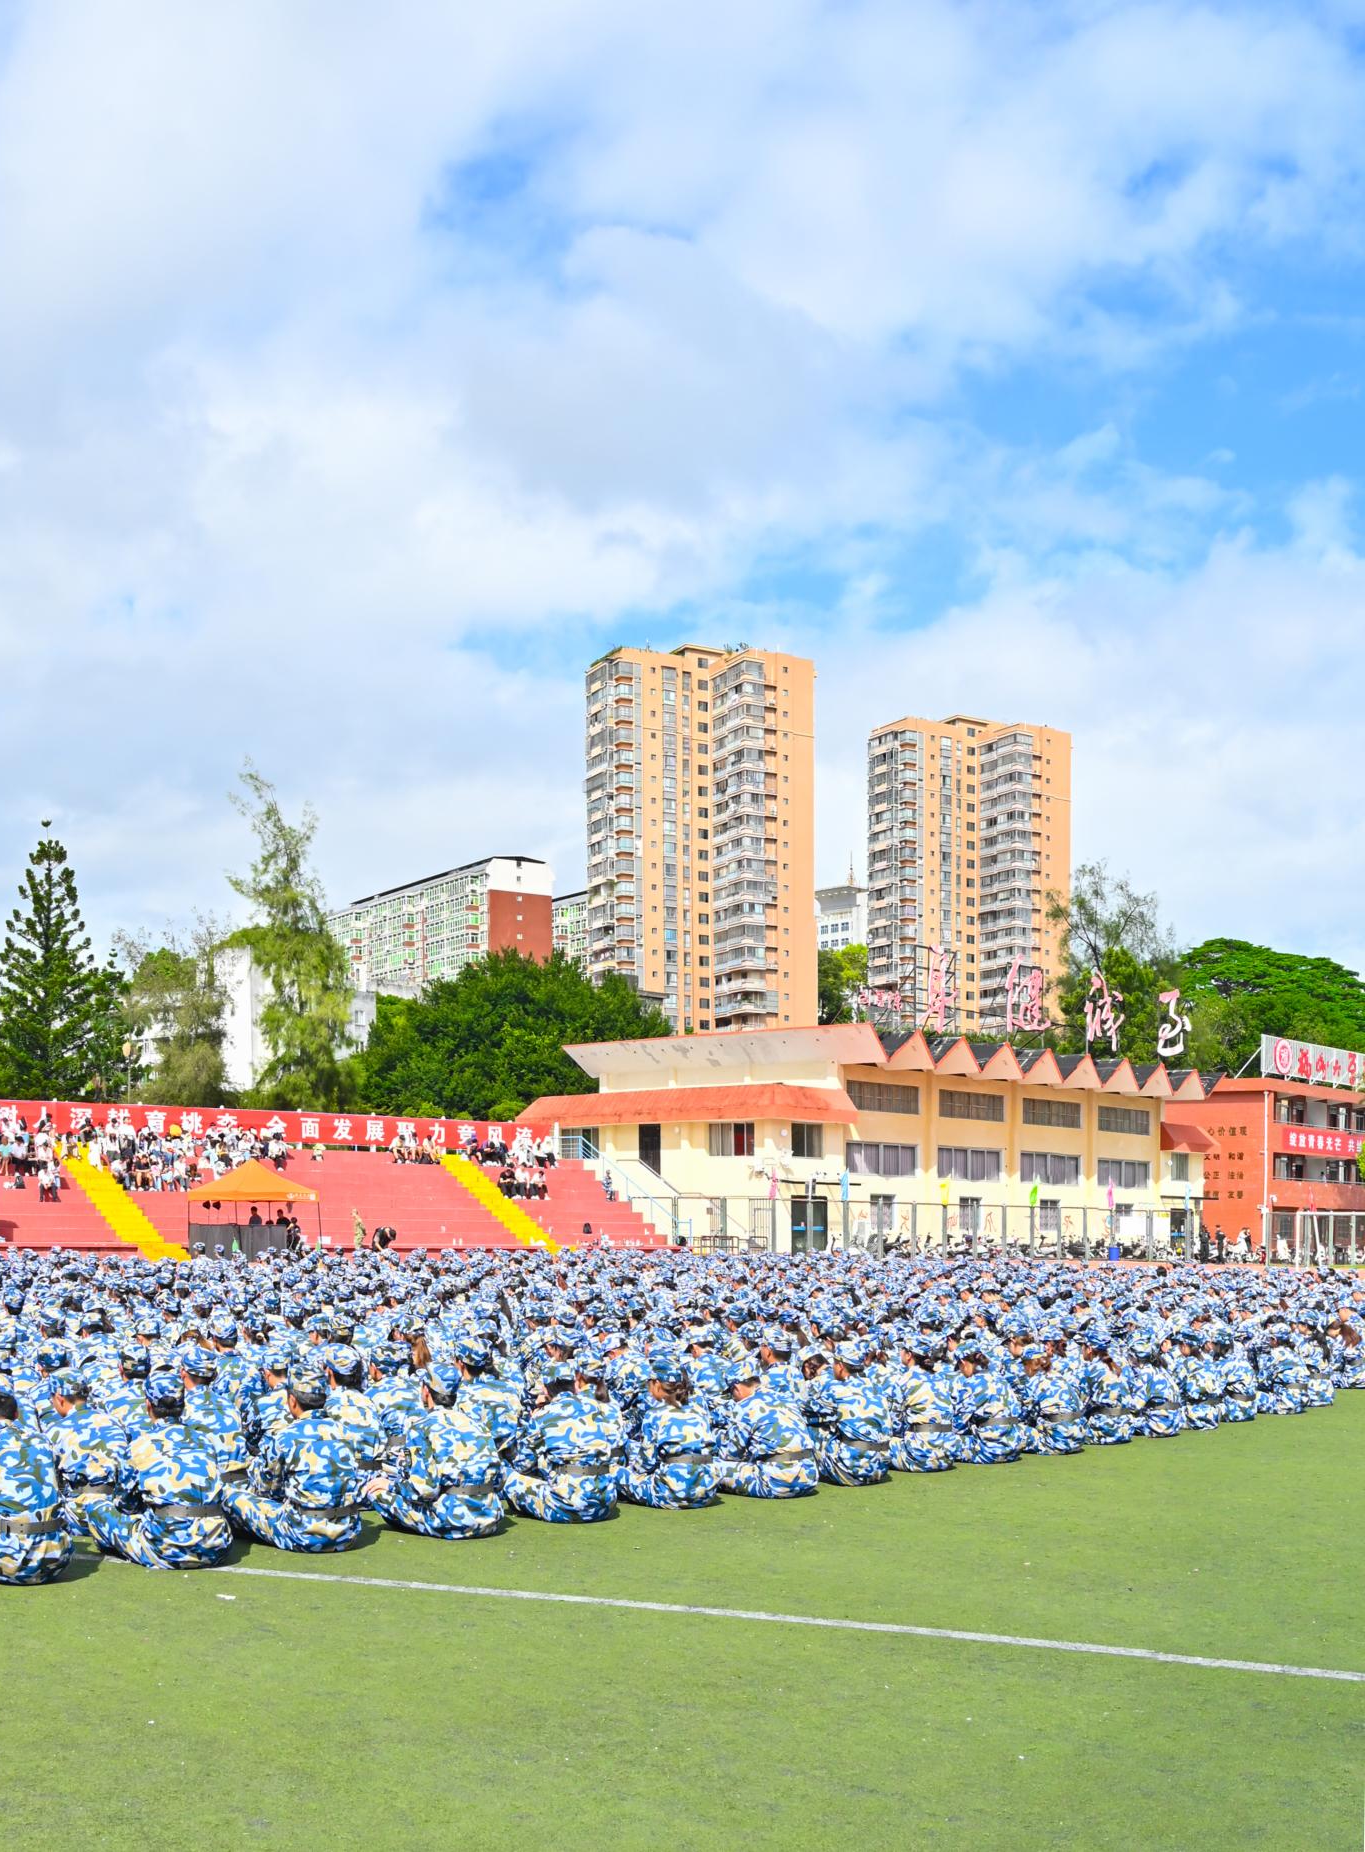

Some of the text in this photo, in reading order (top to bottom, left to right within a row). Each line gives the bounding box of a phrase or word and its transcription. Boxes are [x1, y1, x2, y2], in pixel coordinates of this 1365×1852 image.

[1289, 1131, 1342, 1152] 绽放青春光芒
